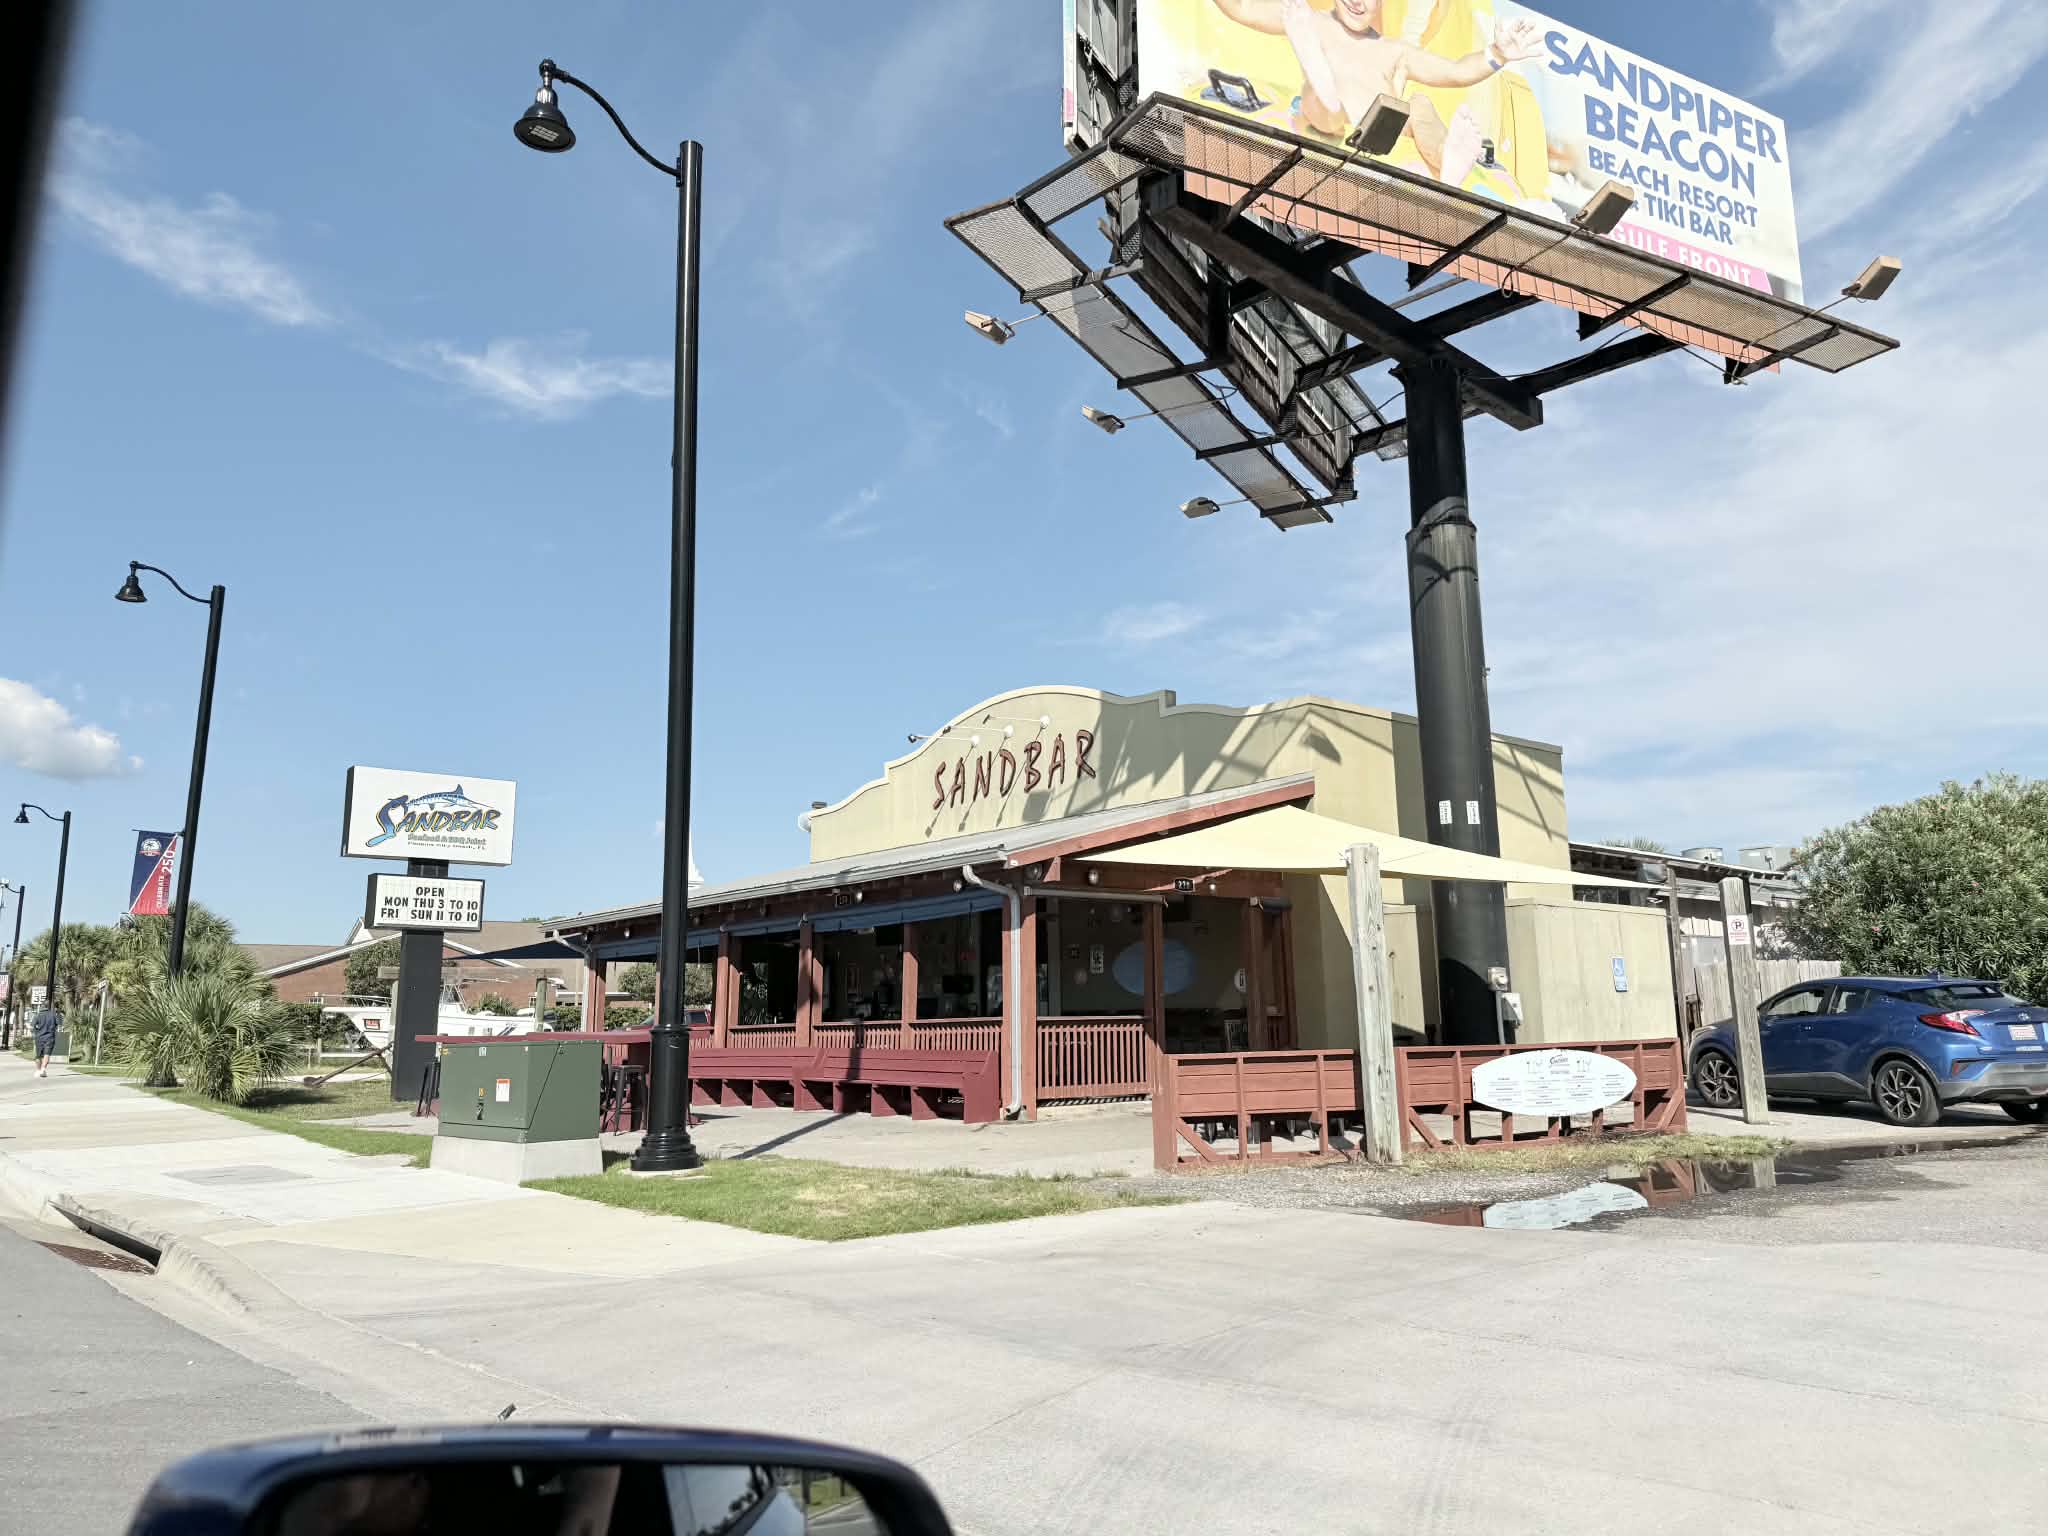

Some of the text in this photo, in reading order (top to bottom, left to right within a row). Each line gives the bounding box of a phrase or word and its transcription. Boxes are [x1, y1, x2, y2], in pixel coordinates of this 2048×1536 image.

[1544, 30, 1782, 163] SANDPIPER
[1584, 94, 1756, 199] BEACON
[1588, 145, 1758, 227] BEACH RESORT
[1643, 192, 1734, 245] TIKI BAR
[1612, 224, 1751, 287] GULF FRONT
[933, 729, 1097, 811] SANDBAR
[366, 795, 503, 847] SANDBAR
[161, 850, 176, 874] 250
[381, 907, 478, 921] FRI SUN 11 TO 10
[384, 896, 478, 910] MON THU 3 TO 10
[416, 886, 445, 897] OPEN
